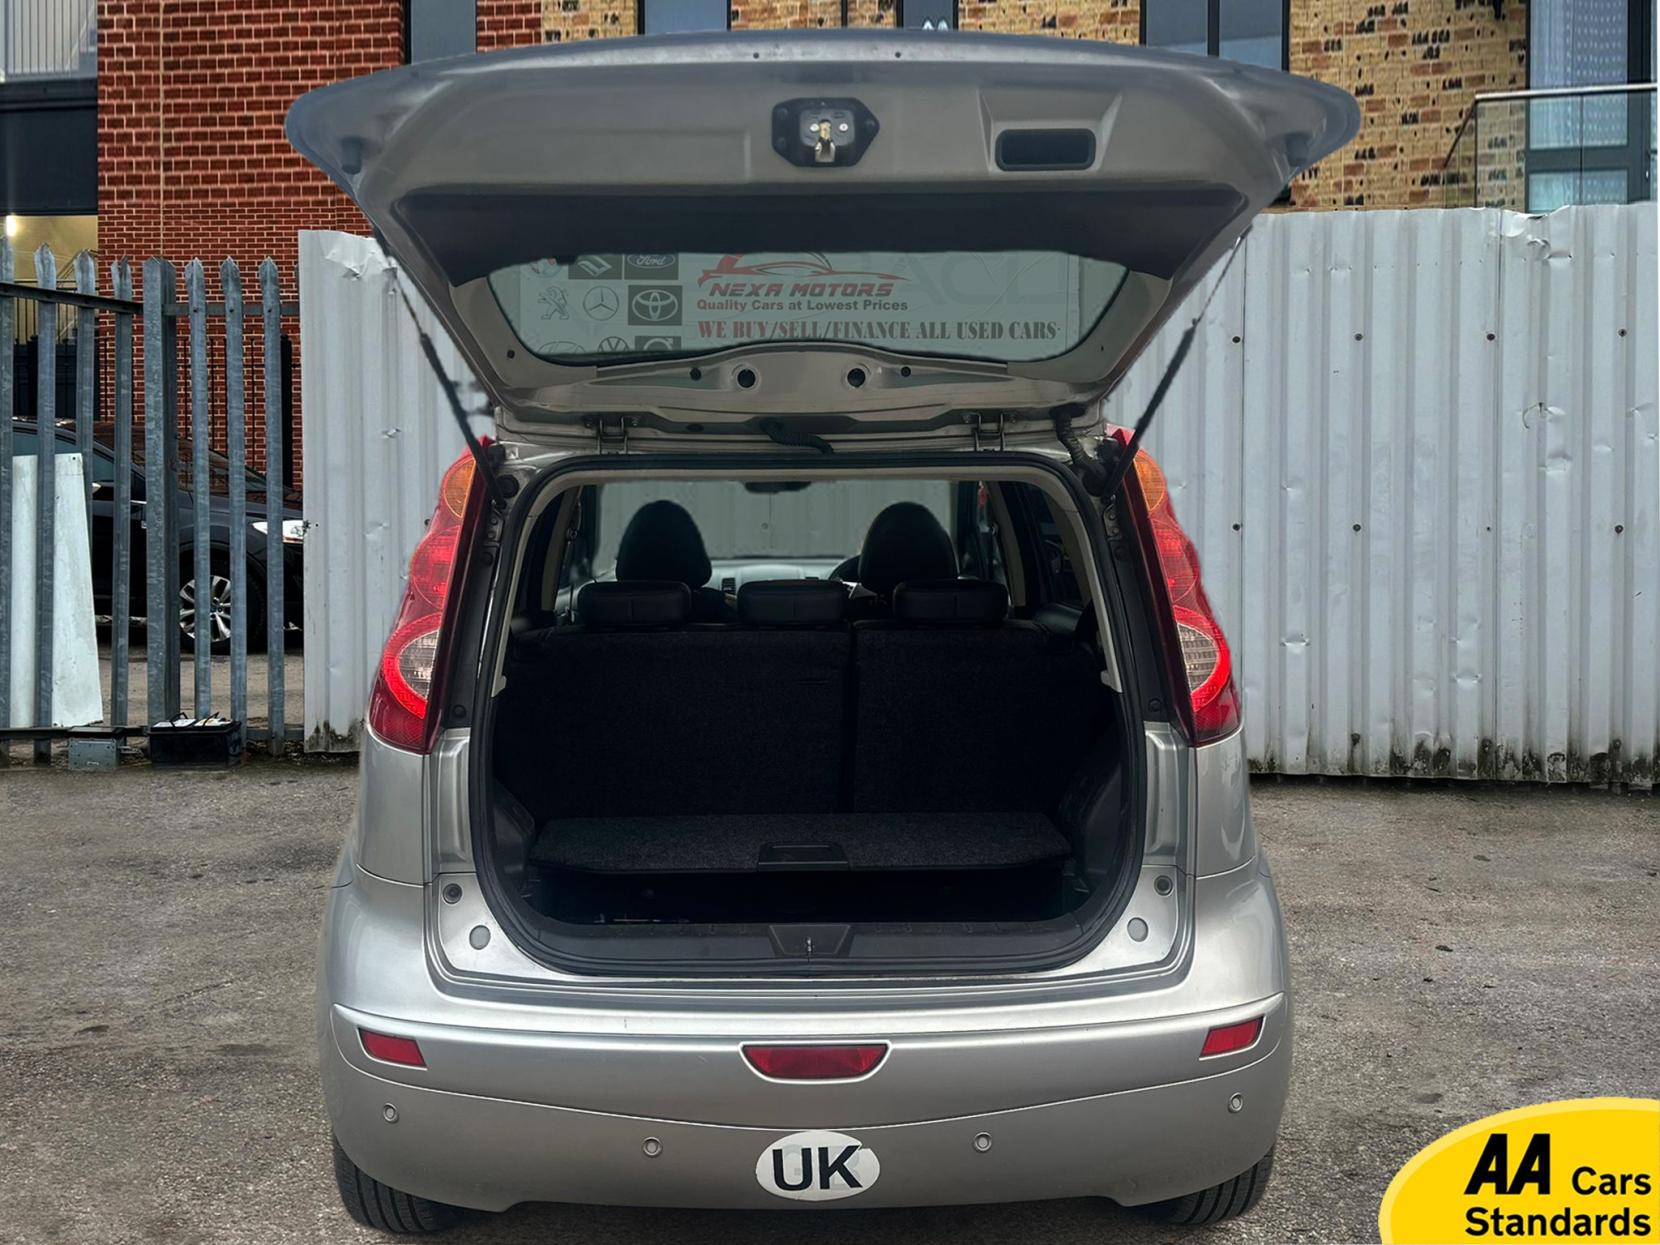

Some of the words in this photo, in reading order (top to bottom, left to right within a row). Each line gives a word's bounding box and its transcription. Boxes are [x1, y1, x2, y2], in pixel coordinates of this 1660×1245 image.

[636, 254, 666, 265] Ford
[709, 283, 784, 297] NEXA
[789, 283, 894, 297] MOTORS
[697, 299, 747, 312] Quality
[752, 299, 784, 311] Cars
[788, 300, 802, 311] at
[807, 300, 858, 311] Lowest
[863, 300, 909, 311] Prices
[698, 320, 727, 339] WE
[916, 321, 950, 340] ALL
[956, 321, 1004, 340] USED
[772, 1145, 863, 1191] UK
